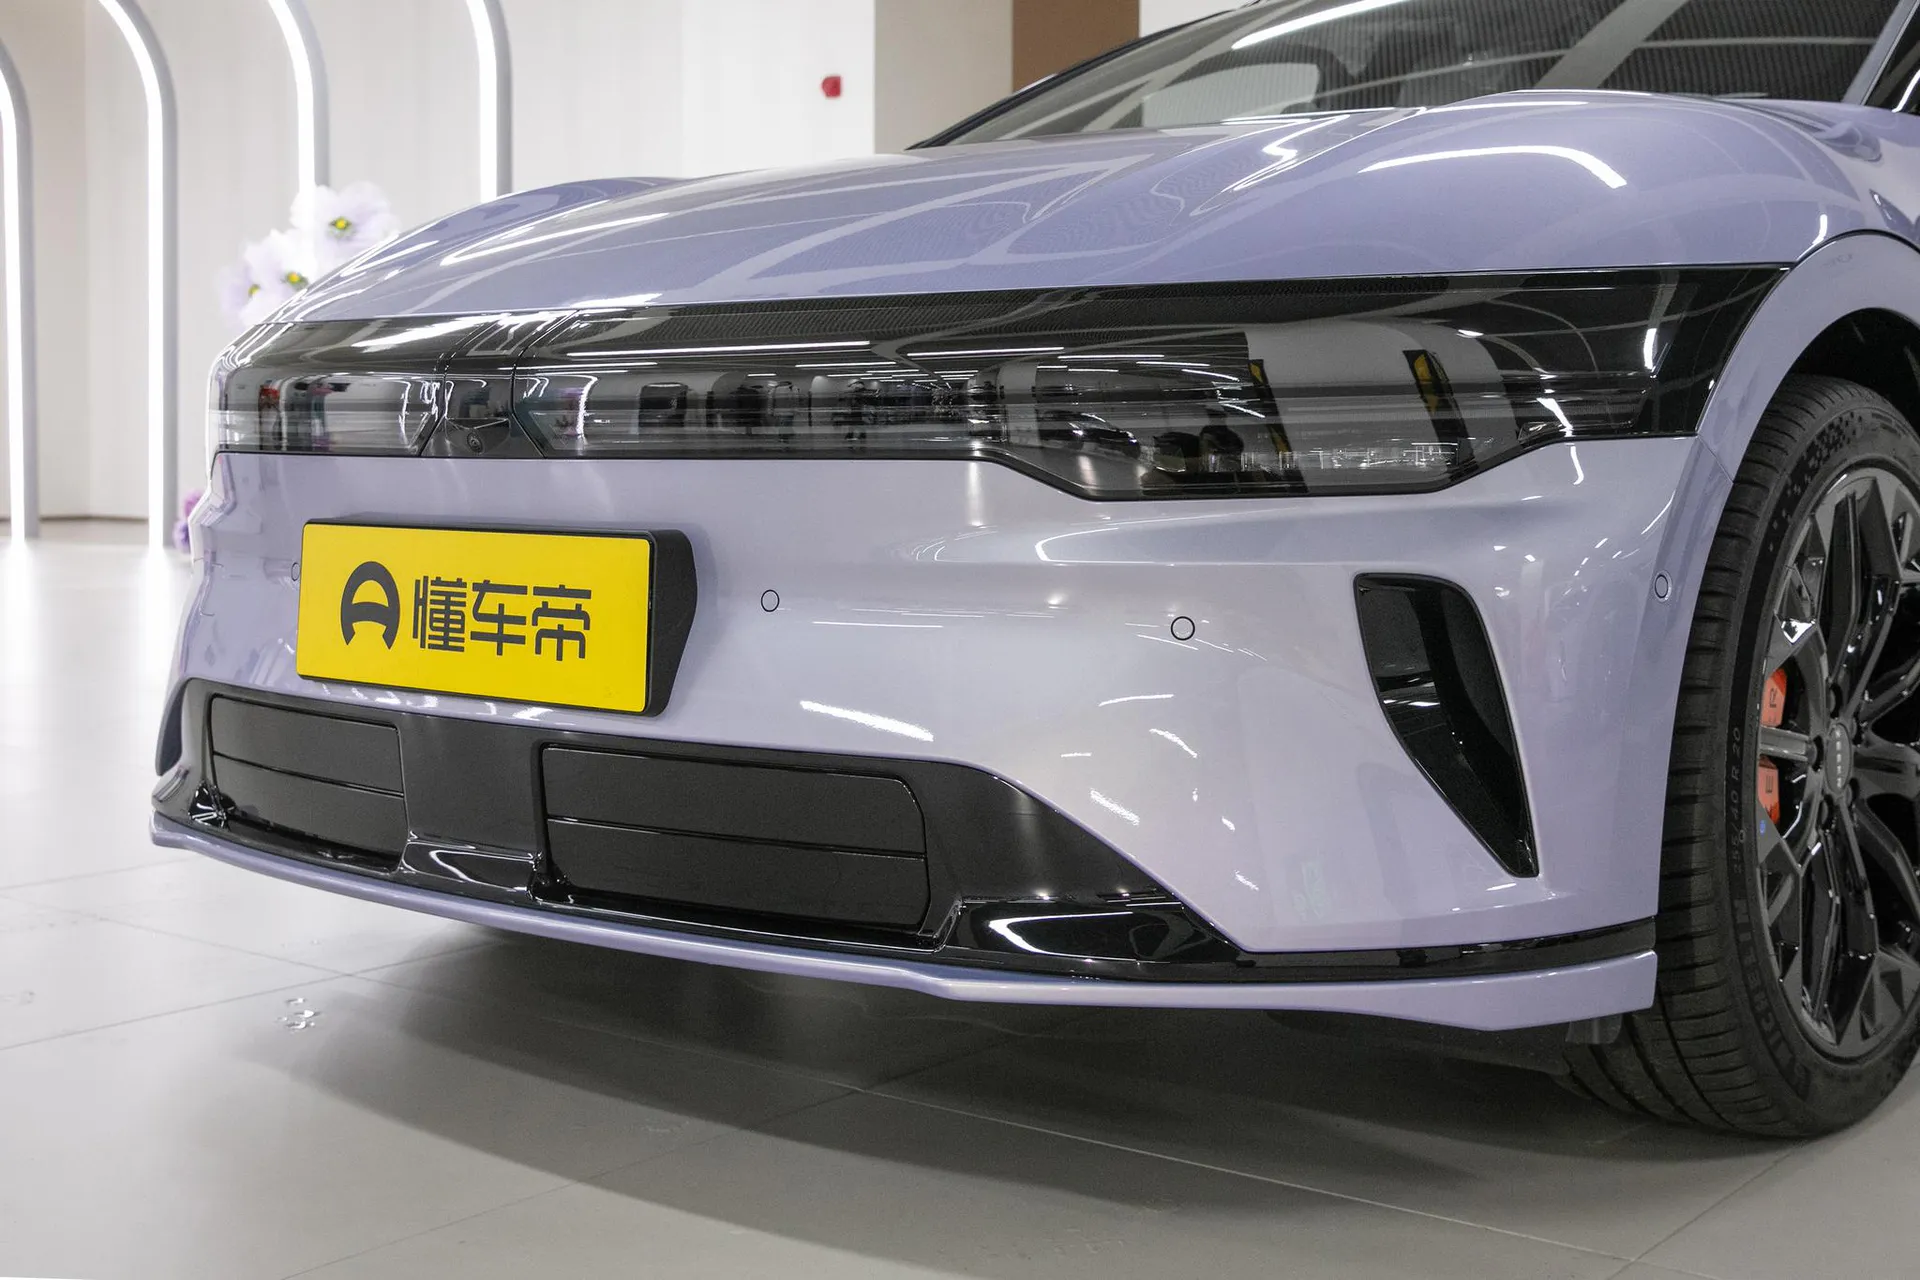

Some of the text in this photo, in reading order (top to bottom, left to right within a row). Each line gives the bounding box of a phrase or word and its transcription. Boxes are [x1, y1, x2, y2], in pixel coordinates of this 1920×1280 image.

[412, 575, 592, 662] 懂车帝
[1731, 727, 1741, 758] 20
[1730, 765, 1739, 780] R
[1734, 898, 1793, 1067] MICHELIN
